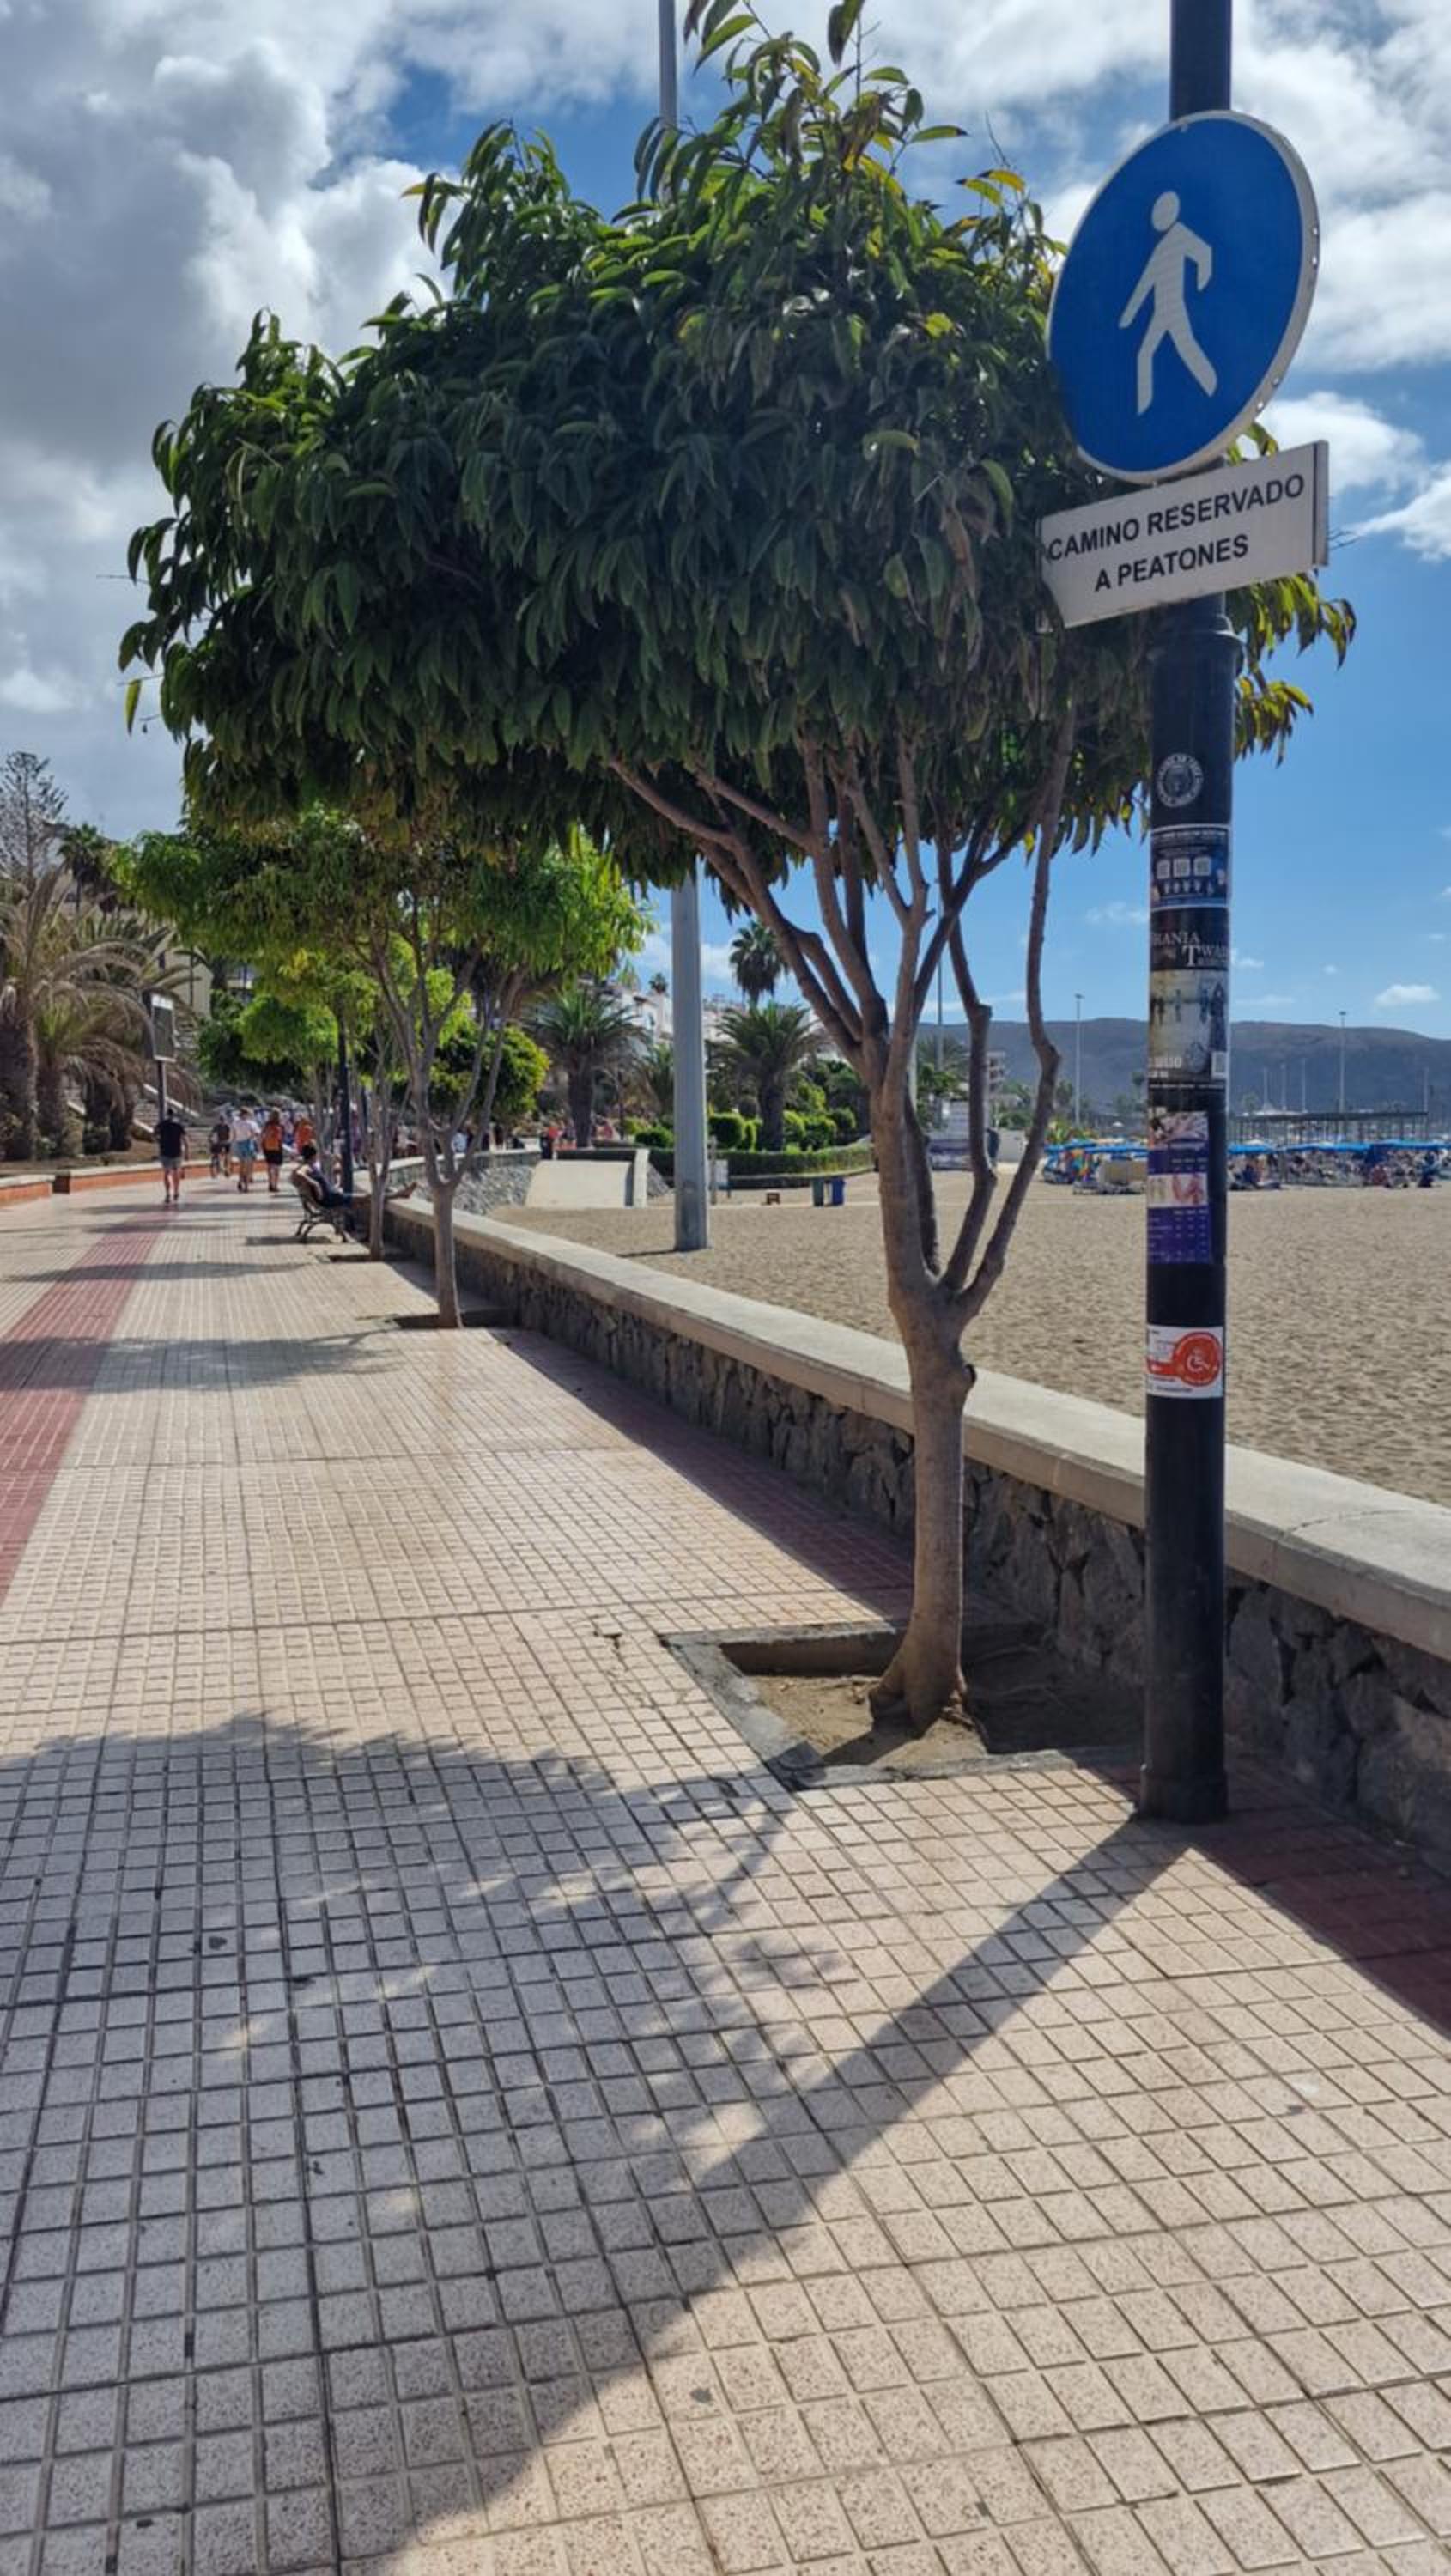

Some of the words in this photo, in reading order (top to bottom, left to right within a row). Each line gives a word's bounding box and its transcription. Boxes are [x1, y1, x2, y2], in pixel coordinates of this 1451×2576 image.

[1047, 518, 1140, 561] CAMINO
[1147, 474, 1305, 536] RESERVADO
[1094, 569, 1111, 592] A
[1117, 533, 1249, 586] PEATONES
